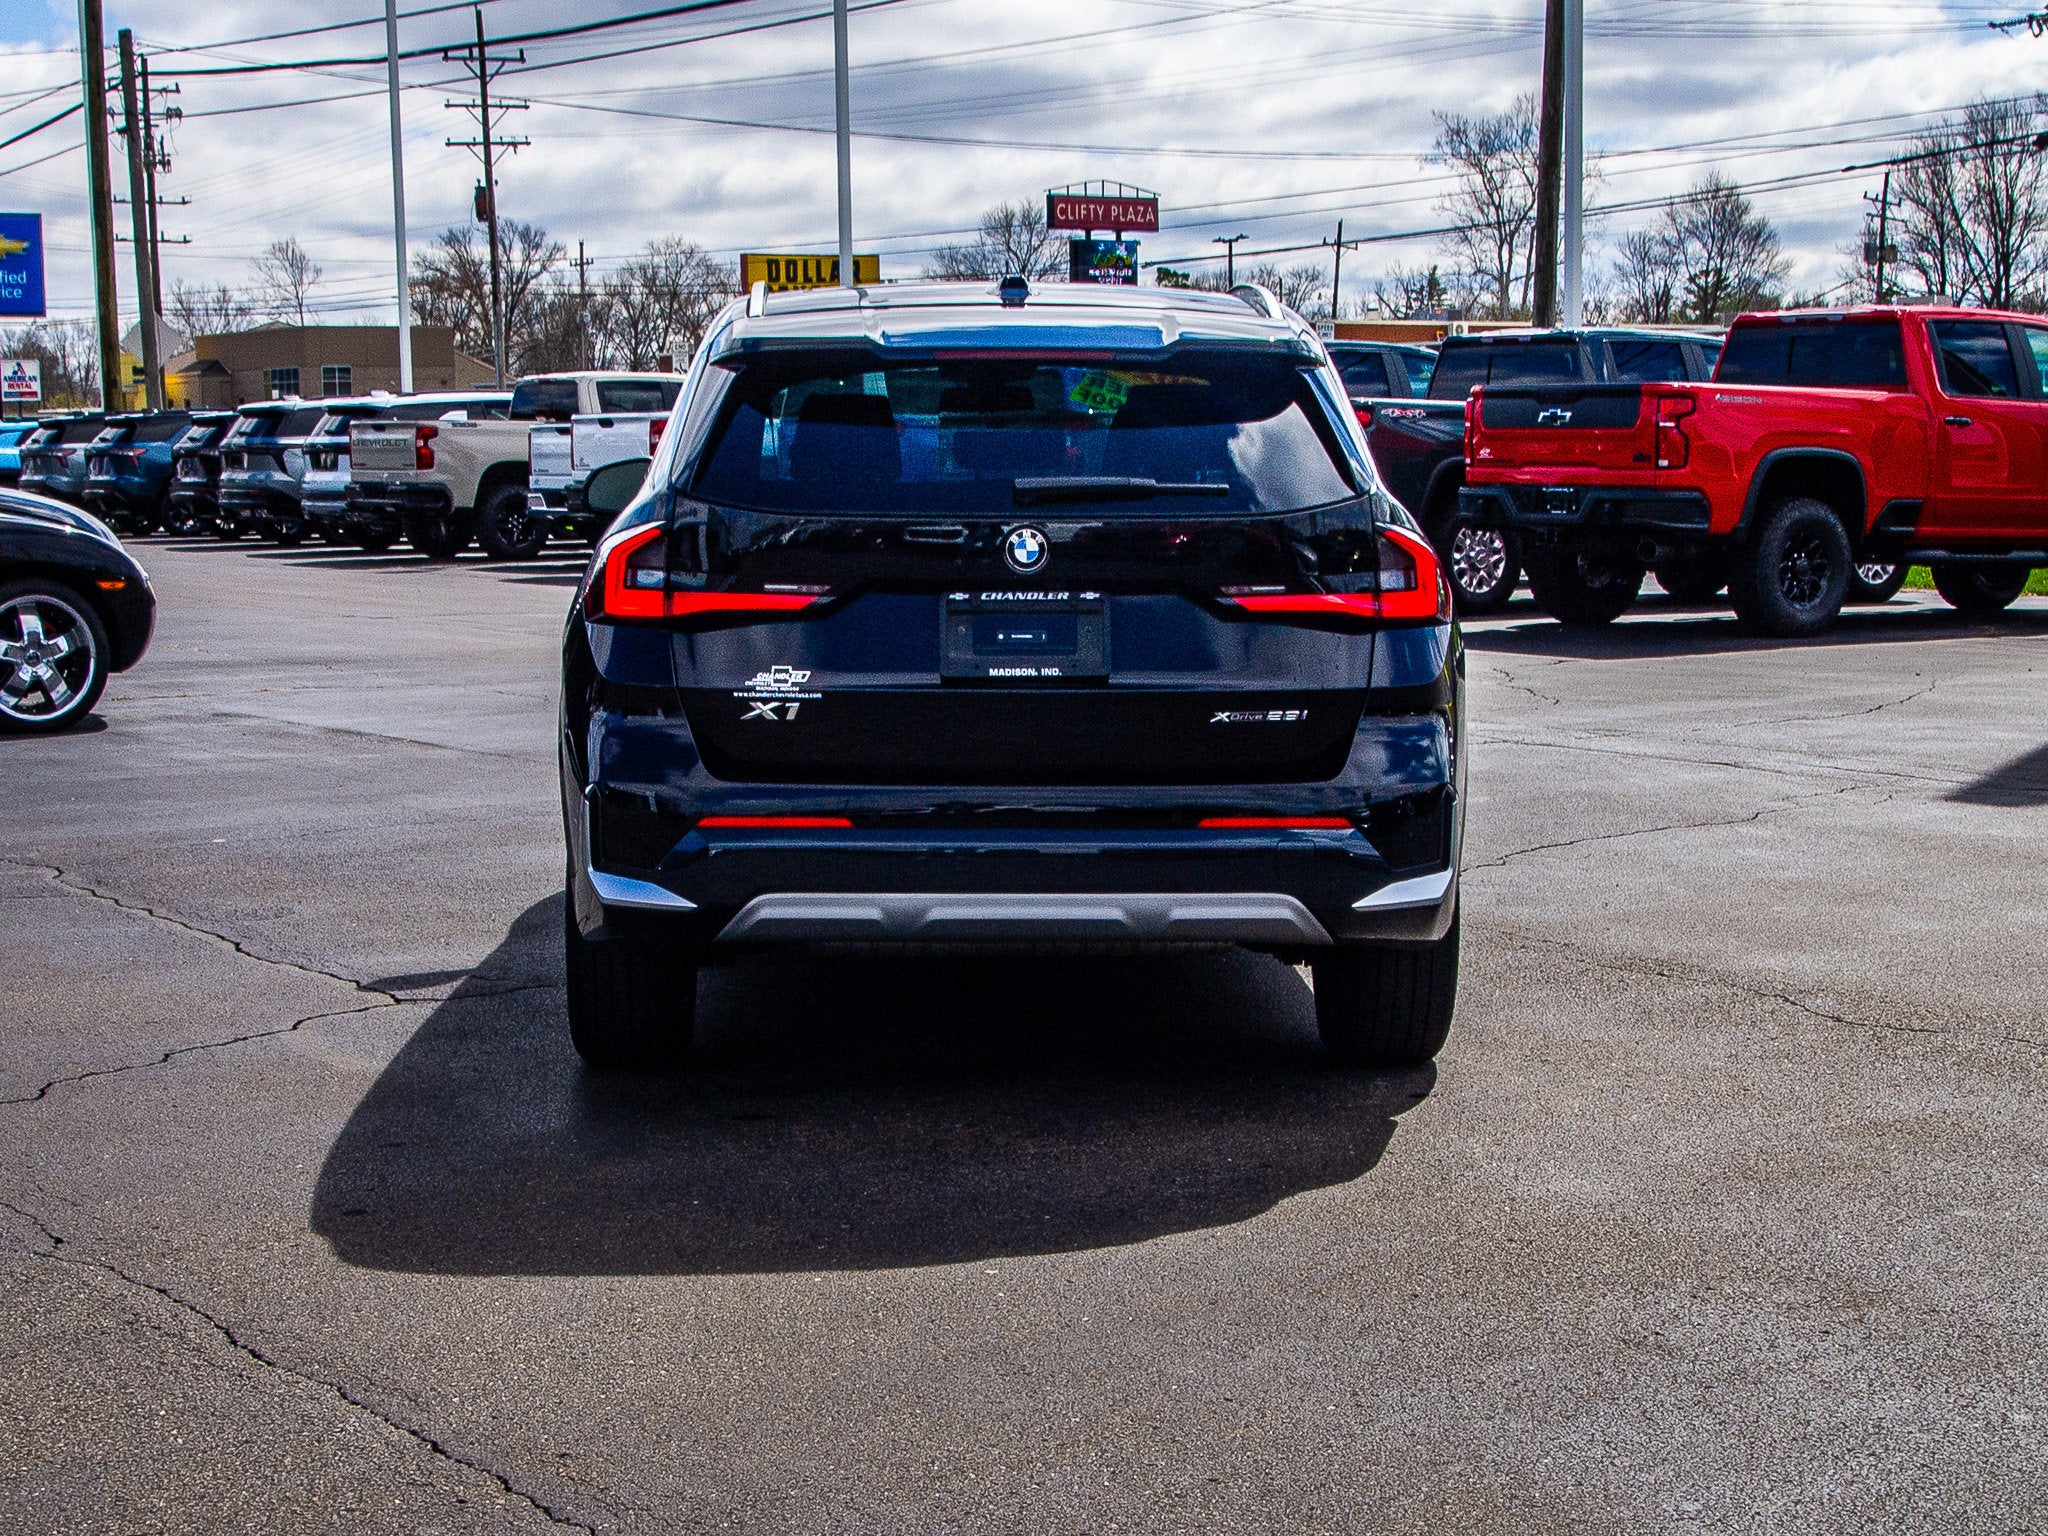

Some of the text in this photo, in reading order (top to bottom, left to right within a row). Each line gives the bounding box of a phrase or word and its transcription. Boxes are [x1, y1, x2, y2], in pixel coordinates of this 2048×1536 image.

[1056, 203, 1155, 222] CLIFTY PLAZA
[1010, 530, 1044, 543] BMW
[981, 592, 1069, 600] CHANDLER
[1041, 668, 1062, 676] IND.
